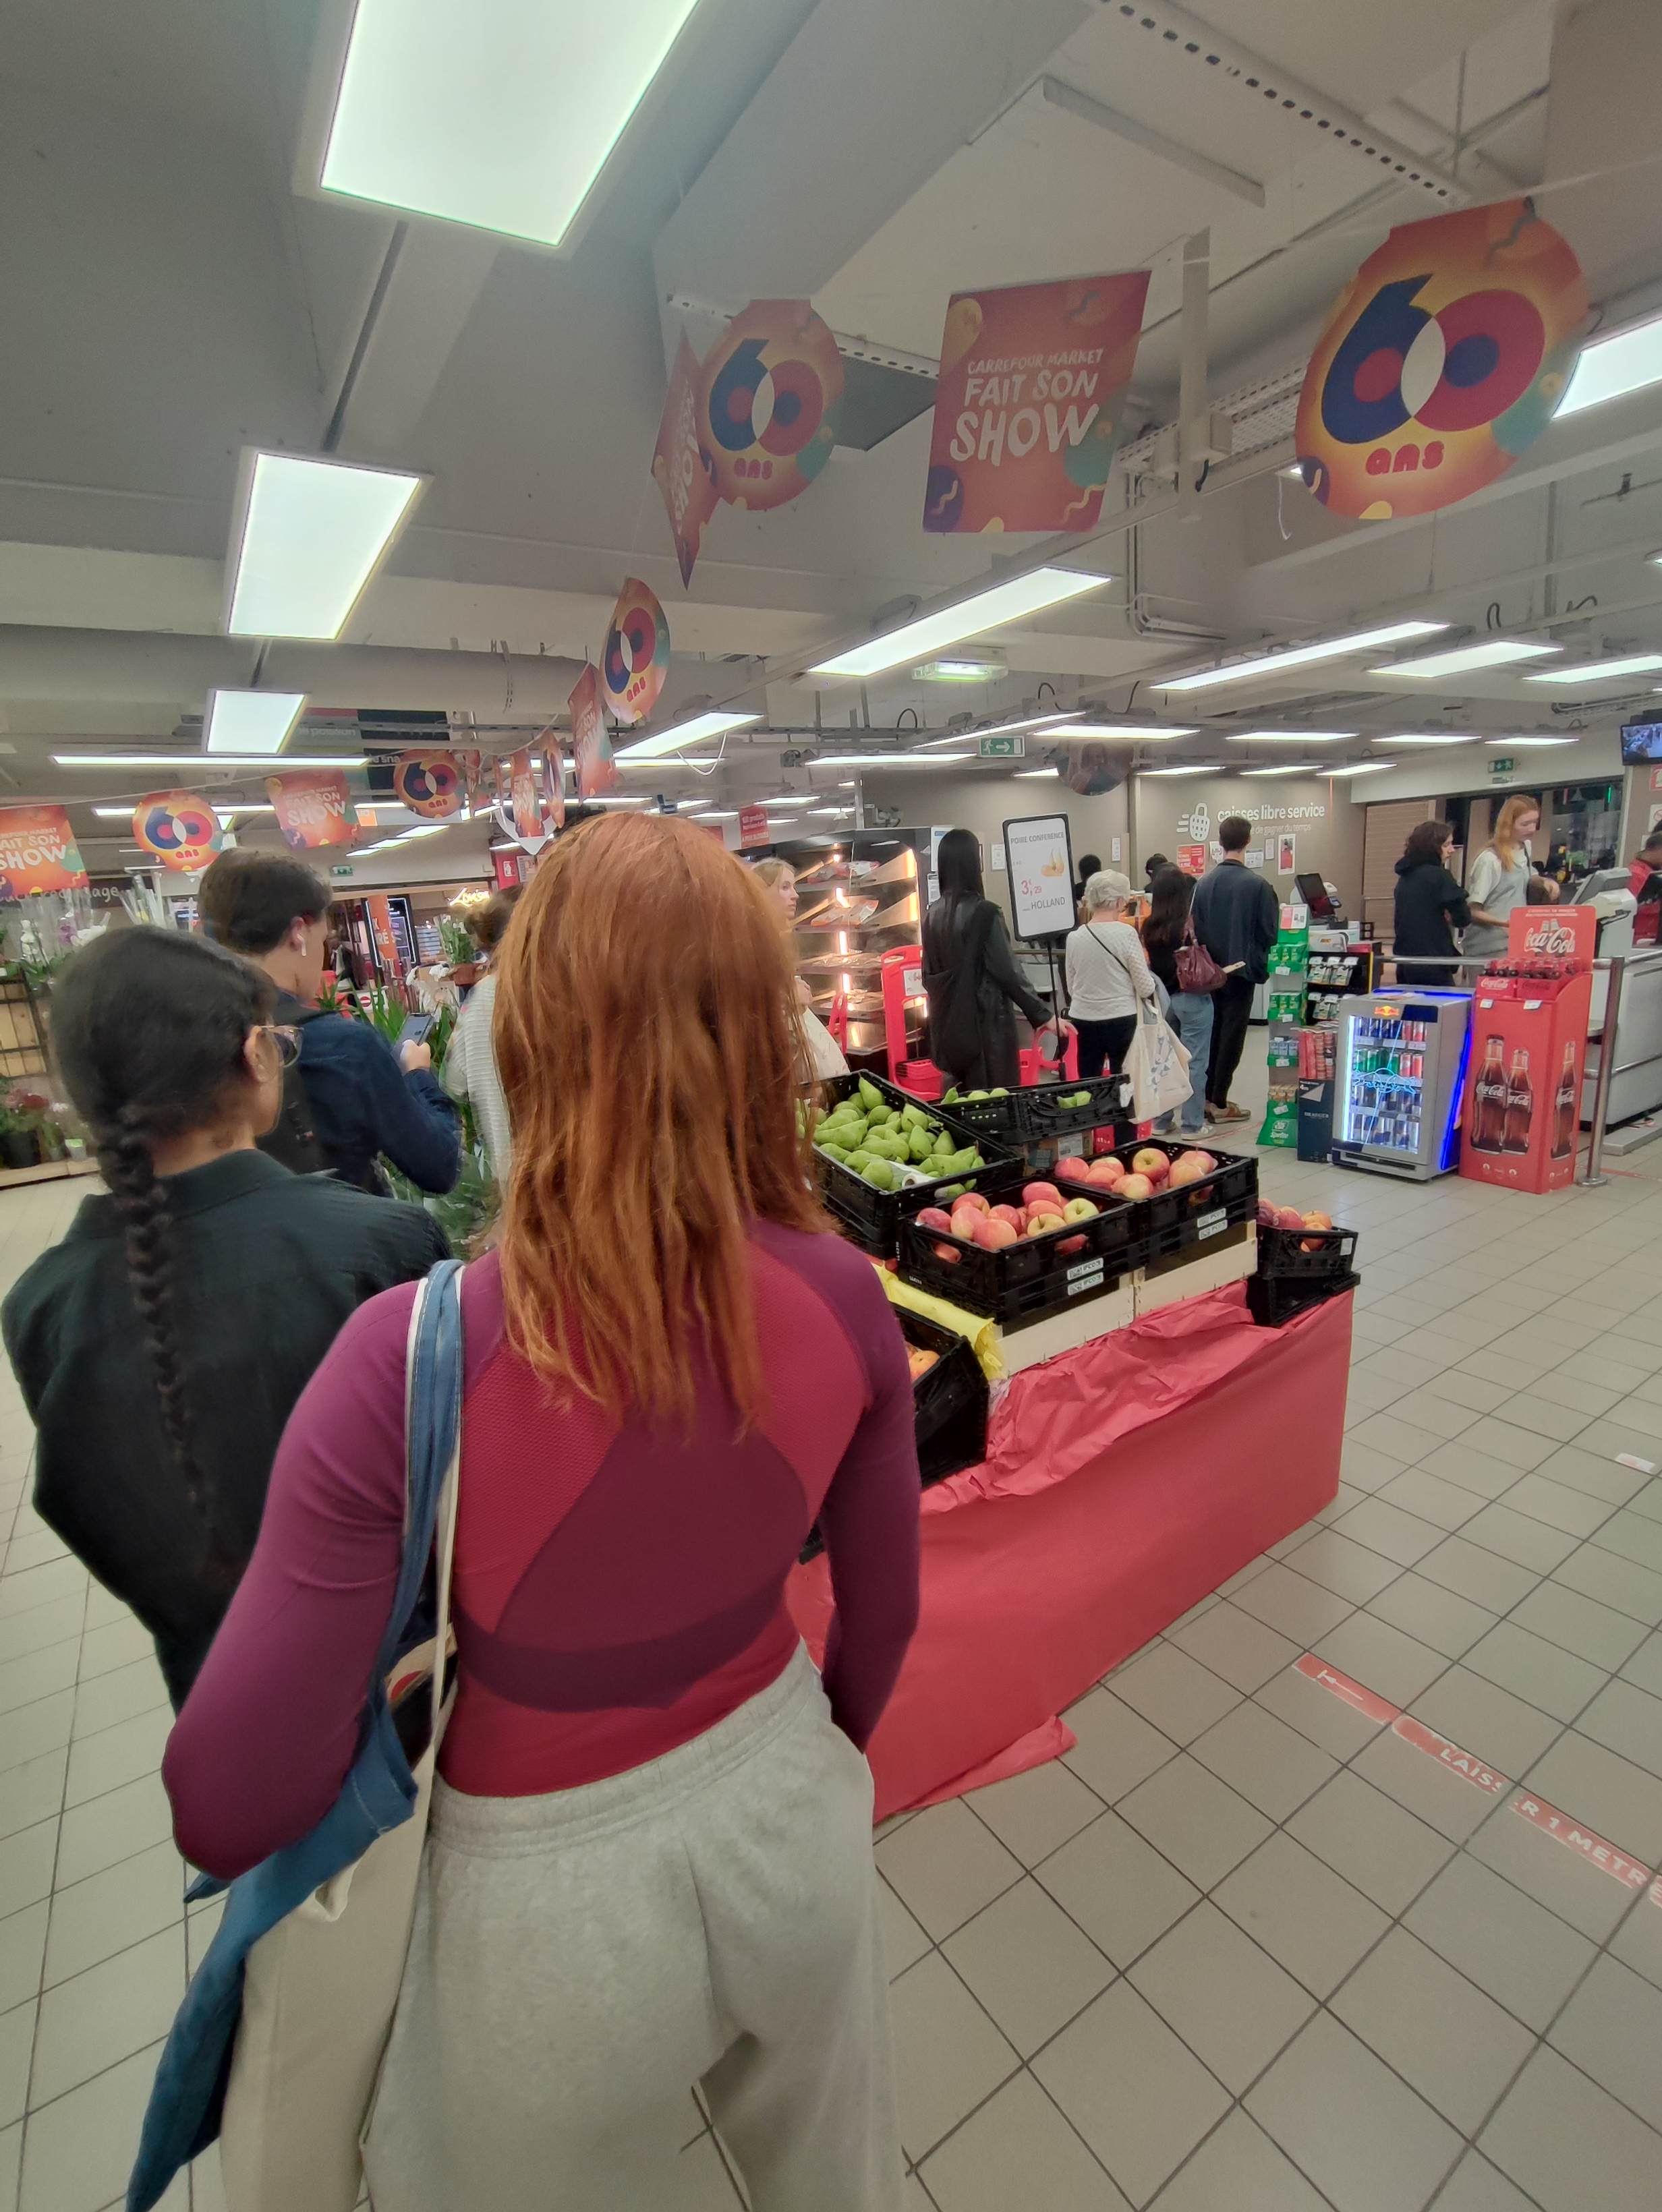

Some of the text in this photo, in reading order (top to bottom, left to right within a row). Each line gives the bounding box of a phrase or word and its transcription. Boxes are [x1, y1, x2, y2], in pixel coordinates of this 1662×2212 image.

[968, 348, 1104, 374] CARREFOUR MARKET
[964, 370, 1099, 407] FAIT SON
[950, 403, 1100, 467] SHOW
[1366, 440, 1444, 475] ans
[315, 792, 341, 803] SON
[287, 801, 345, 826] SHOW
[1261, 804, 1286, 820] libre
[1287, 803, 1325, 819] service
[28, 836, 60, 846] SON
[1031, 896, 1066, 910] HOLLAND
